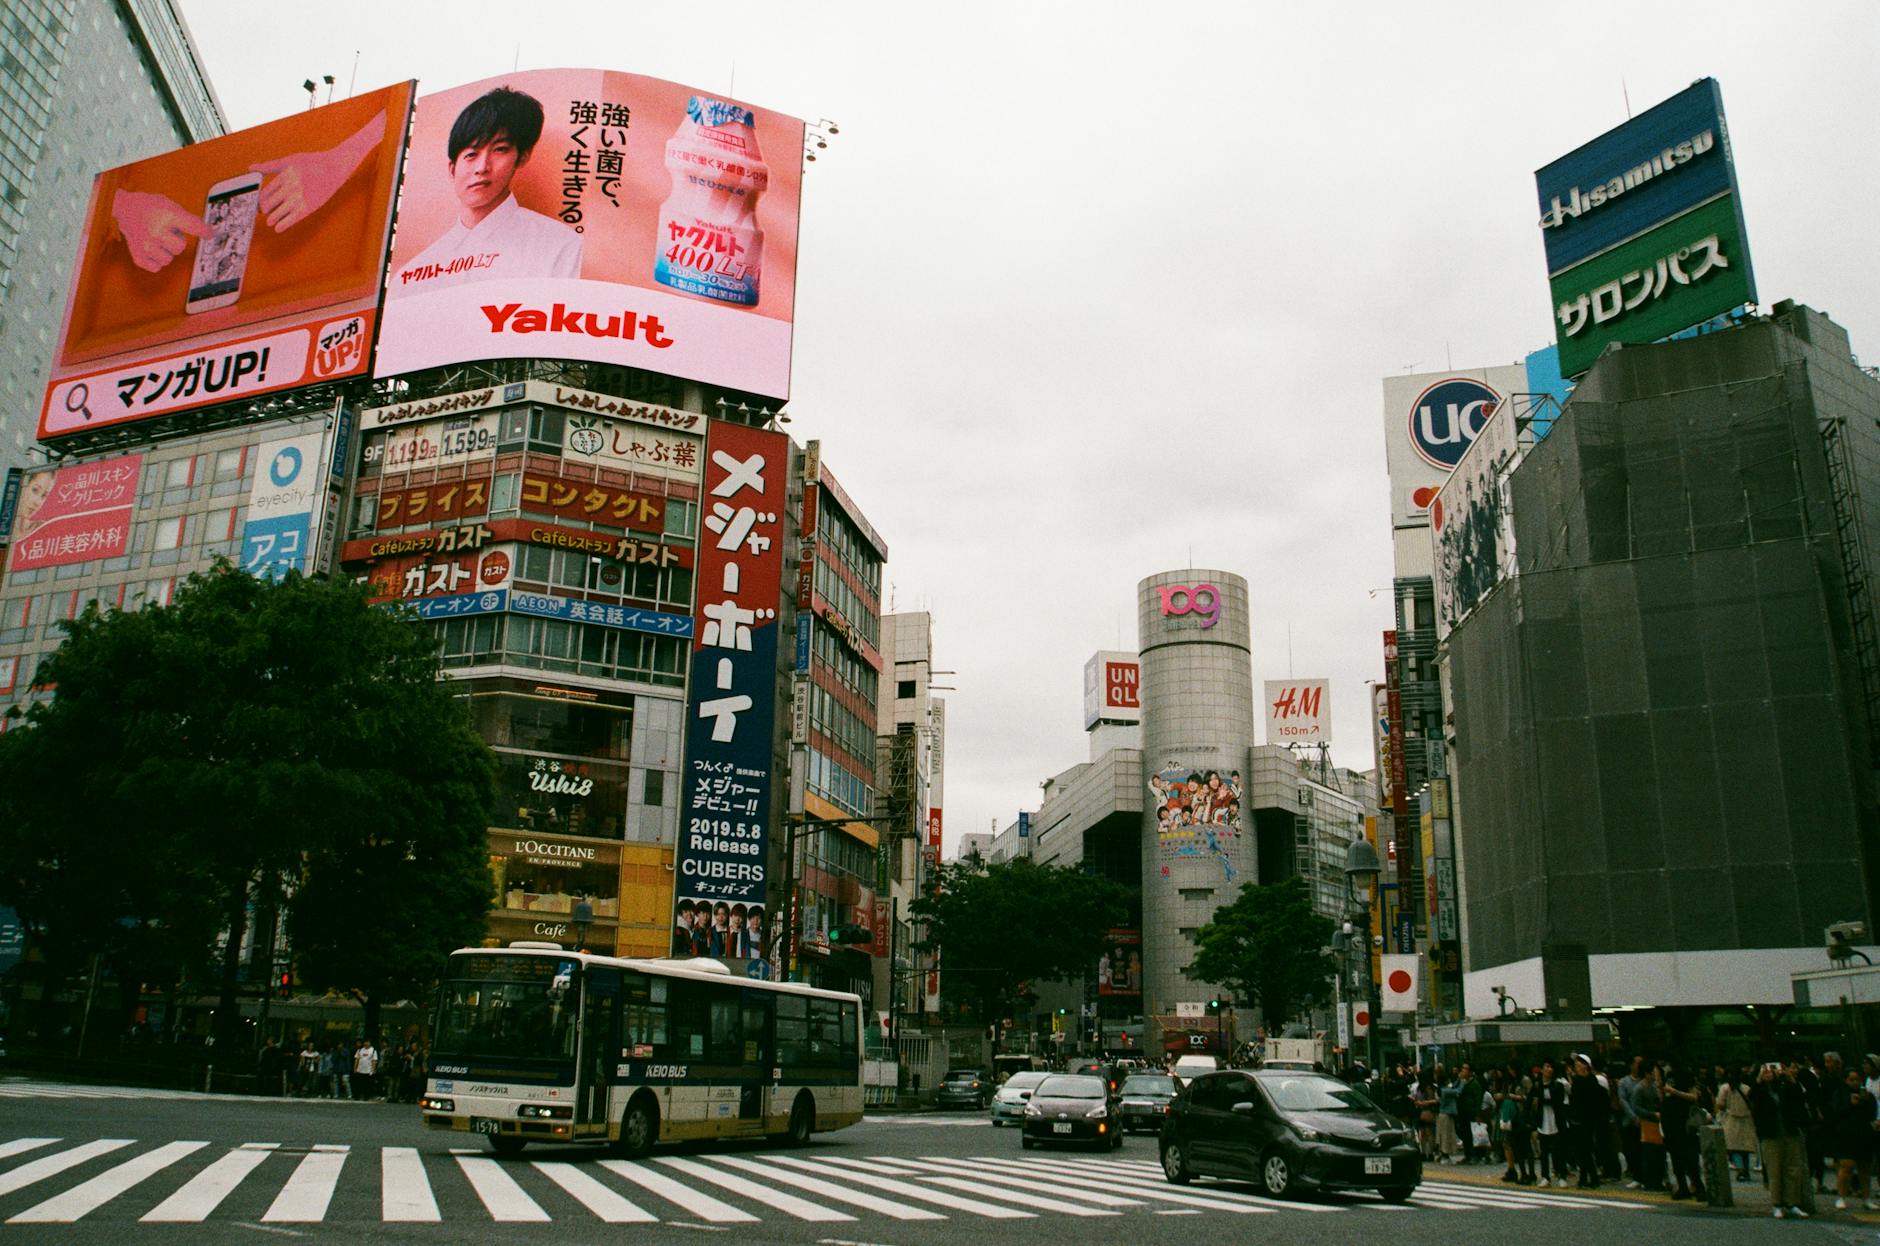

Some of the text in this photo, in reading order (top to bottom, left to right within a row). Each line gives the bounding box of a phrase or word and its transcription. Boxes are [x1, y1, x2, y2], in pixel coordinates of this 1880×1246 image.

[558, 100, 597, 234] 強く生きる。
[595, 102, 630, 209] 強い菌で、
[1539, 128, 1714, 229] Hisamitsu
[668, 220, 745, 256] ヤクルト
[695, 218, 734, 234] Yakult
[1557, 233, 1728, 338] サロンパス
[320, 318, 360, 350] マンガ
[480, 303, 675, 348] Yakult
[316, 333, 363, 376] UP!
[117, 347, 271, 409] マンガUP!
[377, 389, 494, 424] しゃぶしゃぶバイキング
[556, 387, 699, 429] しゃぶしゃぶバイキング
[363, 445, 385, 462] 9F
[612, 429, 697, 468] しゃぶ葉
[75, 465, 134, 490] 品川スキン
[72, 484, 125, 507] クリニック
[257, 486, 305, 508] eyecity
[382, 481, 487, 520] プライス
[523, 479, 661, 523] コンタクト
[28, 525, 122, 560] 品川美容外科
[438, 525, 492, 552] ガスト
[616, 539, 679, 568] ガスト
[402, 560, 471, 598] ガスト
[484, 565, 507, 577] ガスト
[517, 595, 690, 633] AEON 英会話イーオン
[1156, 584, 1221, 629] 109
[1111, 668, 1136, 684] UN
[1273, 687, 1322, 719] H&M
[695, 776, 761, 796] メジャー
[690, 817, 762, 840] 2019.5.8
[690, 834, 760, 856] Release
[682, 858, 765, 882] CUBERS
[694, 881, 754, 896] キューバーズ
[534, 922, 566, 939] Café
[646, 1065, 687, 1078] KEIO BUS
